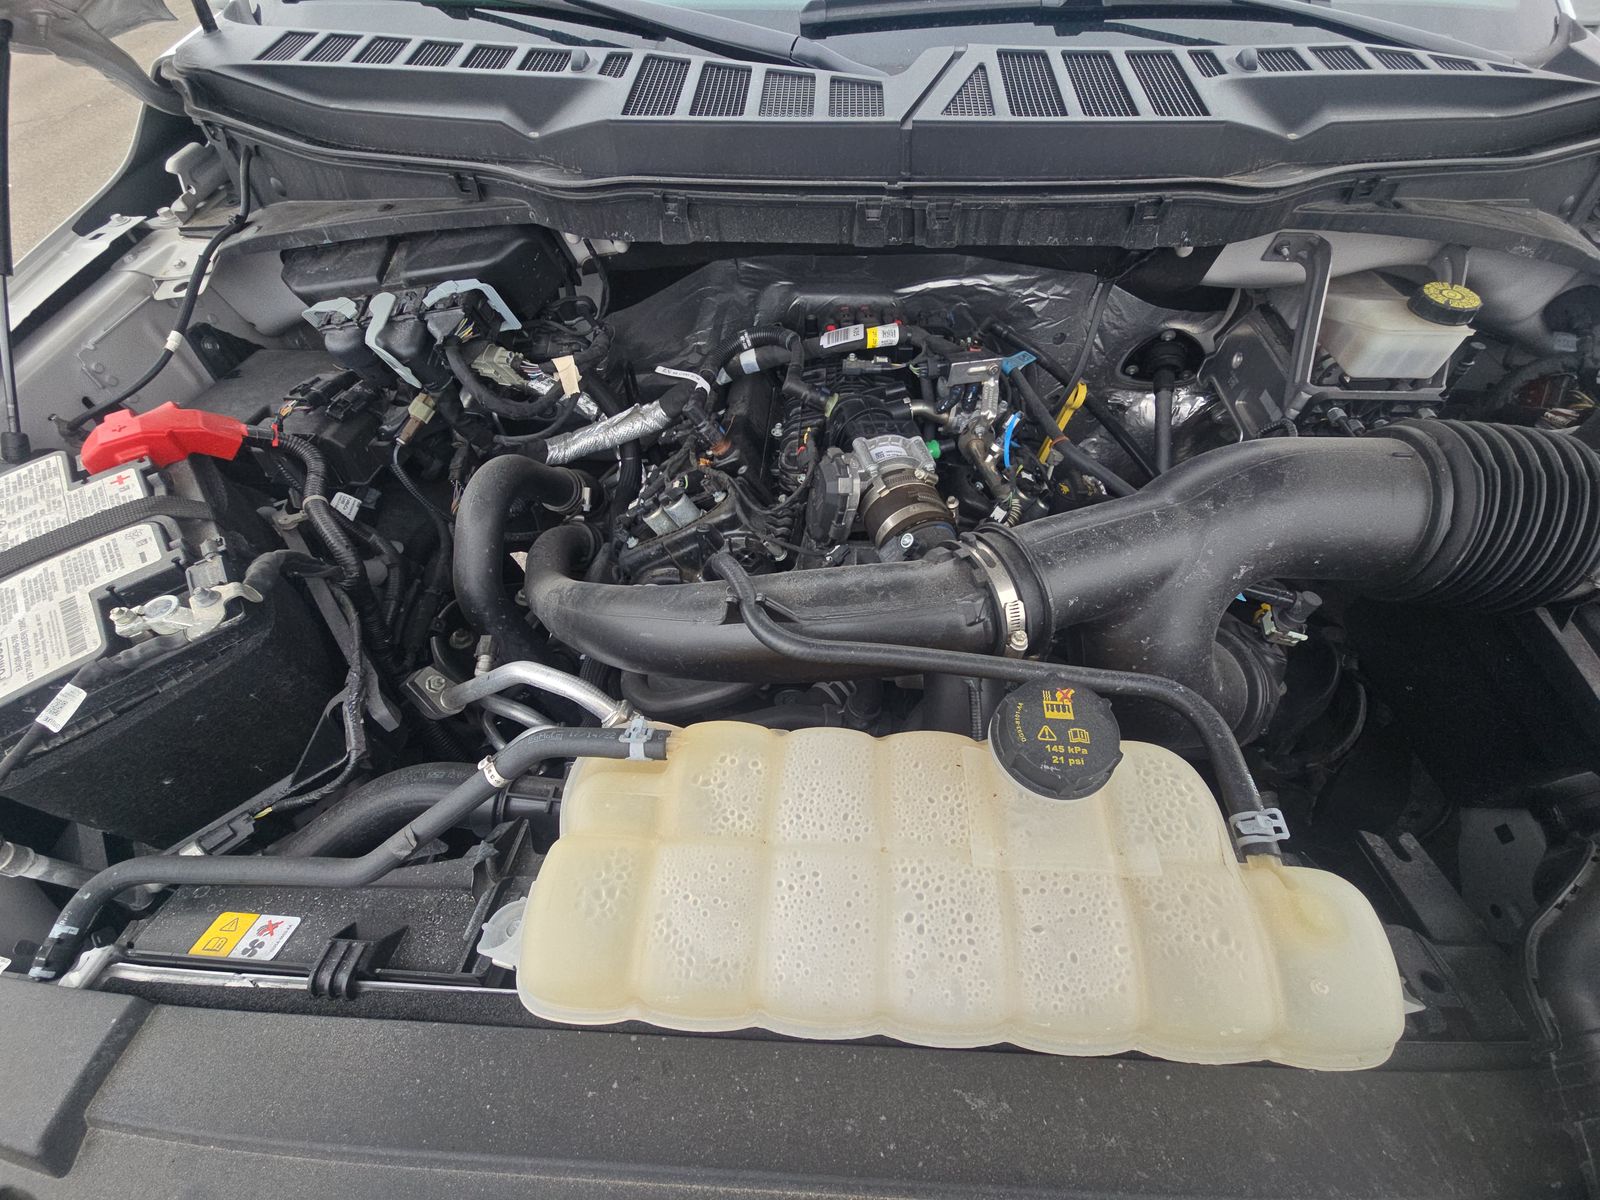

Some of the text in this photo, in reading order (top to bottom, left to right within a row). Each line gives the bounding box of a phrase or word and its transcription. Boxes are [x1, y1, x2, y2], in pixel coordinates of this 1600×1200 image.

[1045, 744, 1088, 754] 145 kPa
[1051, 756, 1085, 766] 21 psi
